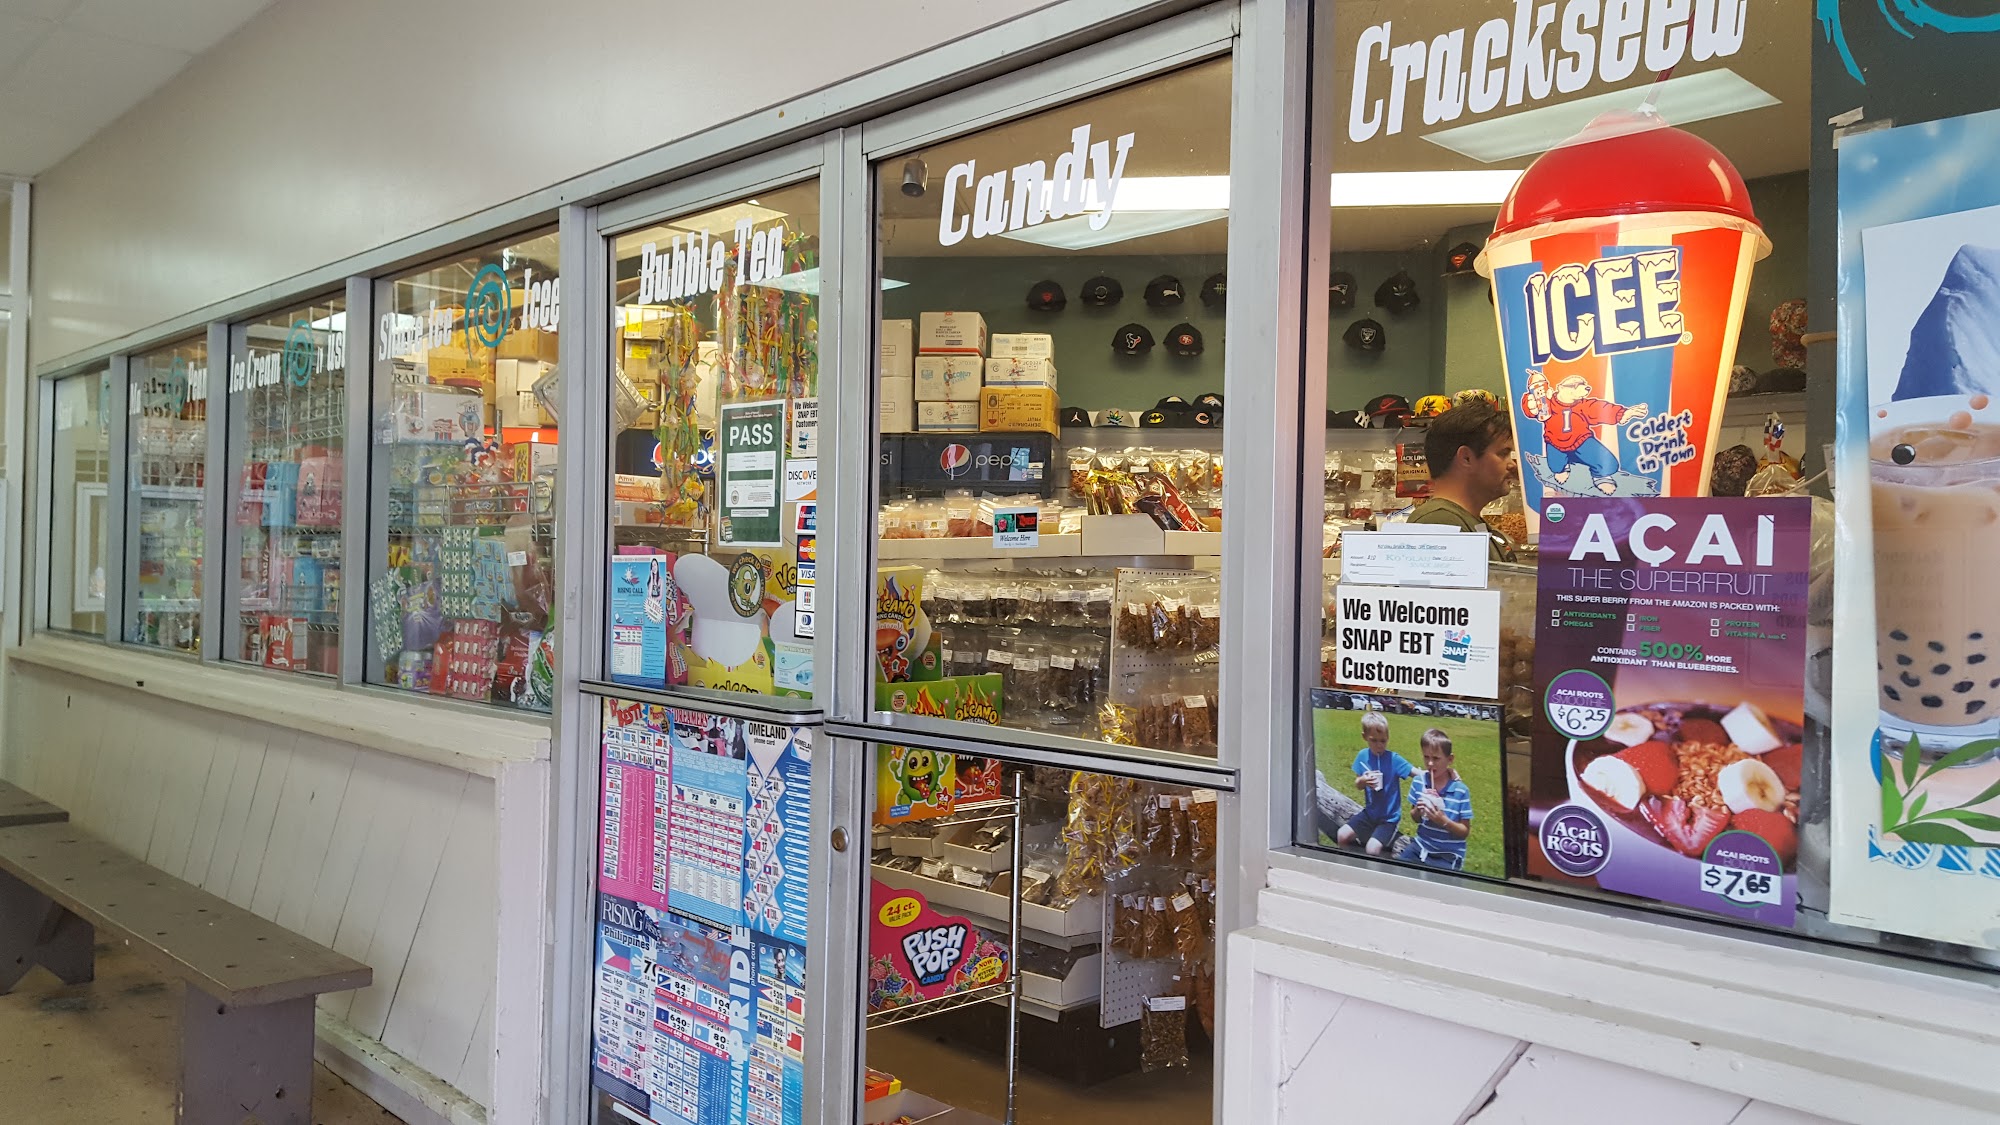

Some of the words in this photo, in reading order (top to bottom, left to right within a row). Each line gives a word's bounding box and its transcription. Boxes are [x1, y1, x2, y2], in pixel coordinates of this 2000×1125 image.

[1349, 0, 1747, 143] Crackseed
[939, 124, 1135, 247] Candy
[638, 228, 725, 305] Bubble
[734, 217, 785, 286] Tea
[521, 268, 560, 330] Icee
[1525, 249, 1684, 366] ICEE
[427, 300, 453, 349] Ice
[229, 354, 245, 394] Ice
[247, 349, 281, 390] Cream
[795, 402, 801, 410] We
[798, 411, 809, 419] SNAP
[810, 410, 818, 418] EBT
[1629, 412, 1691, 439] Coldest
[729, 423, 773, 447] PASS
[1642, 429, 1686, 455] Drink
[975, 452, 1025, 469] pepsi
[1639, 457, 1656, 470] in
[1660, 447, 1694, 465] Town
[1567, 567, 1613, 590] THE
[1619, 569, 1773, 596] SUPERFRUIT
[1556, 594, 1574, 602] THIS
[1575, 595, 1601, 603] SUPER
[1602, 596, 1628, 604] BERRY
[1630, 597, 1653, 606] FROM
[1655, 599, 1671, 608] THE
[1672, 600, 1708, 609] AMAZON
[1709, 601, 1718, 609] IS
[1719, 602, 1754, 611] PACKED
[1755, 604, 1781, 613] WITH:
[887, 612, 905, 621] CANDY
[1342, 598, 1371, 620] We
[1378, 599, 1469, 626] Welcome
[1563, 610, 1617, 620] ANTIOXIDANTS
[1725, 620, 1760, 628] PROTEIN
[1342, 627, 1392, 652] SNAP
[1400, 631, 1434, 655] EBT
[1725, 630, 1758, 639] VITAMIN
[1443, 646, 1468, 656] SNAP
[1597, 646, 1637, 657] CONTAINS
[1640, 641, 1704, 661] 500%
[1705, 654, 1733, 664] MORE
[1342, 656, 1449, 687] Customers
[1591, 655, 1648, 666] ANTIOXIDANT
[1651, 659, 1676, 669] THAN
[1677, 662, 1739, 674] BLUEBERRIES.
[1556, 688, 1576, 697] ACAI
[1577, 690, 1604, 699] ROOTS
[1558, 705, 1607, 730] $6.25
[754, 737, 765, 746] phone
[691, 793, 699, 801] 72
[709, 798, 717, 806] 80
[1716, 849, 1738, 860] ACAI
[1739, 853, 1770, 865] ROOTS
[1704, 865, 1772, 896] $7.65
[602, 900, 643, 932] RISING
[886, 903, 901, 917] 24
[903, 901, 916, 912] ct.
[888, 914, 901, 923] VALUE
[901, 911, 913, 920] PACK
[604, 926, 650, 951] Philippines
[902, 925, 967, 962] PUSH
[911, 947, 961, 979] POP
[978, 958, 993, 969] NOW
[921, 973, 946, 984] CANDY
[977, 966, 996, 977] MYSTERY
[979, 971, 996, 982] FLAVOR
[674, 981, 686, 992] 84
[676, 989, 686, 998] 42
[728, 923, 751, 1062] PRIDE
[666, 1004, 682, 1015] Guam
[713, 997, 730, 1010] 104
[669, 1014, 687, 1027] 640
[706, 1021, 724, 1033] Palau
[759, 1011, 769, 1020] New
[769, 1014, 785, 1027] Zealand
[713, 1033, 726, 1043] 80
[714, 1041, 725, 1050] 40
